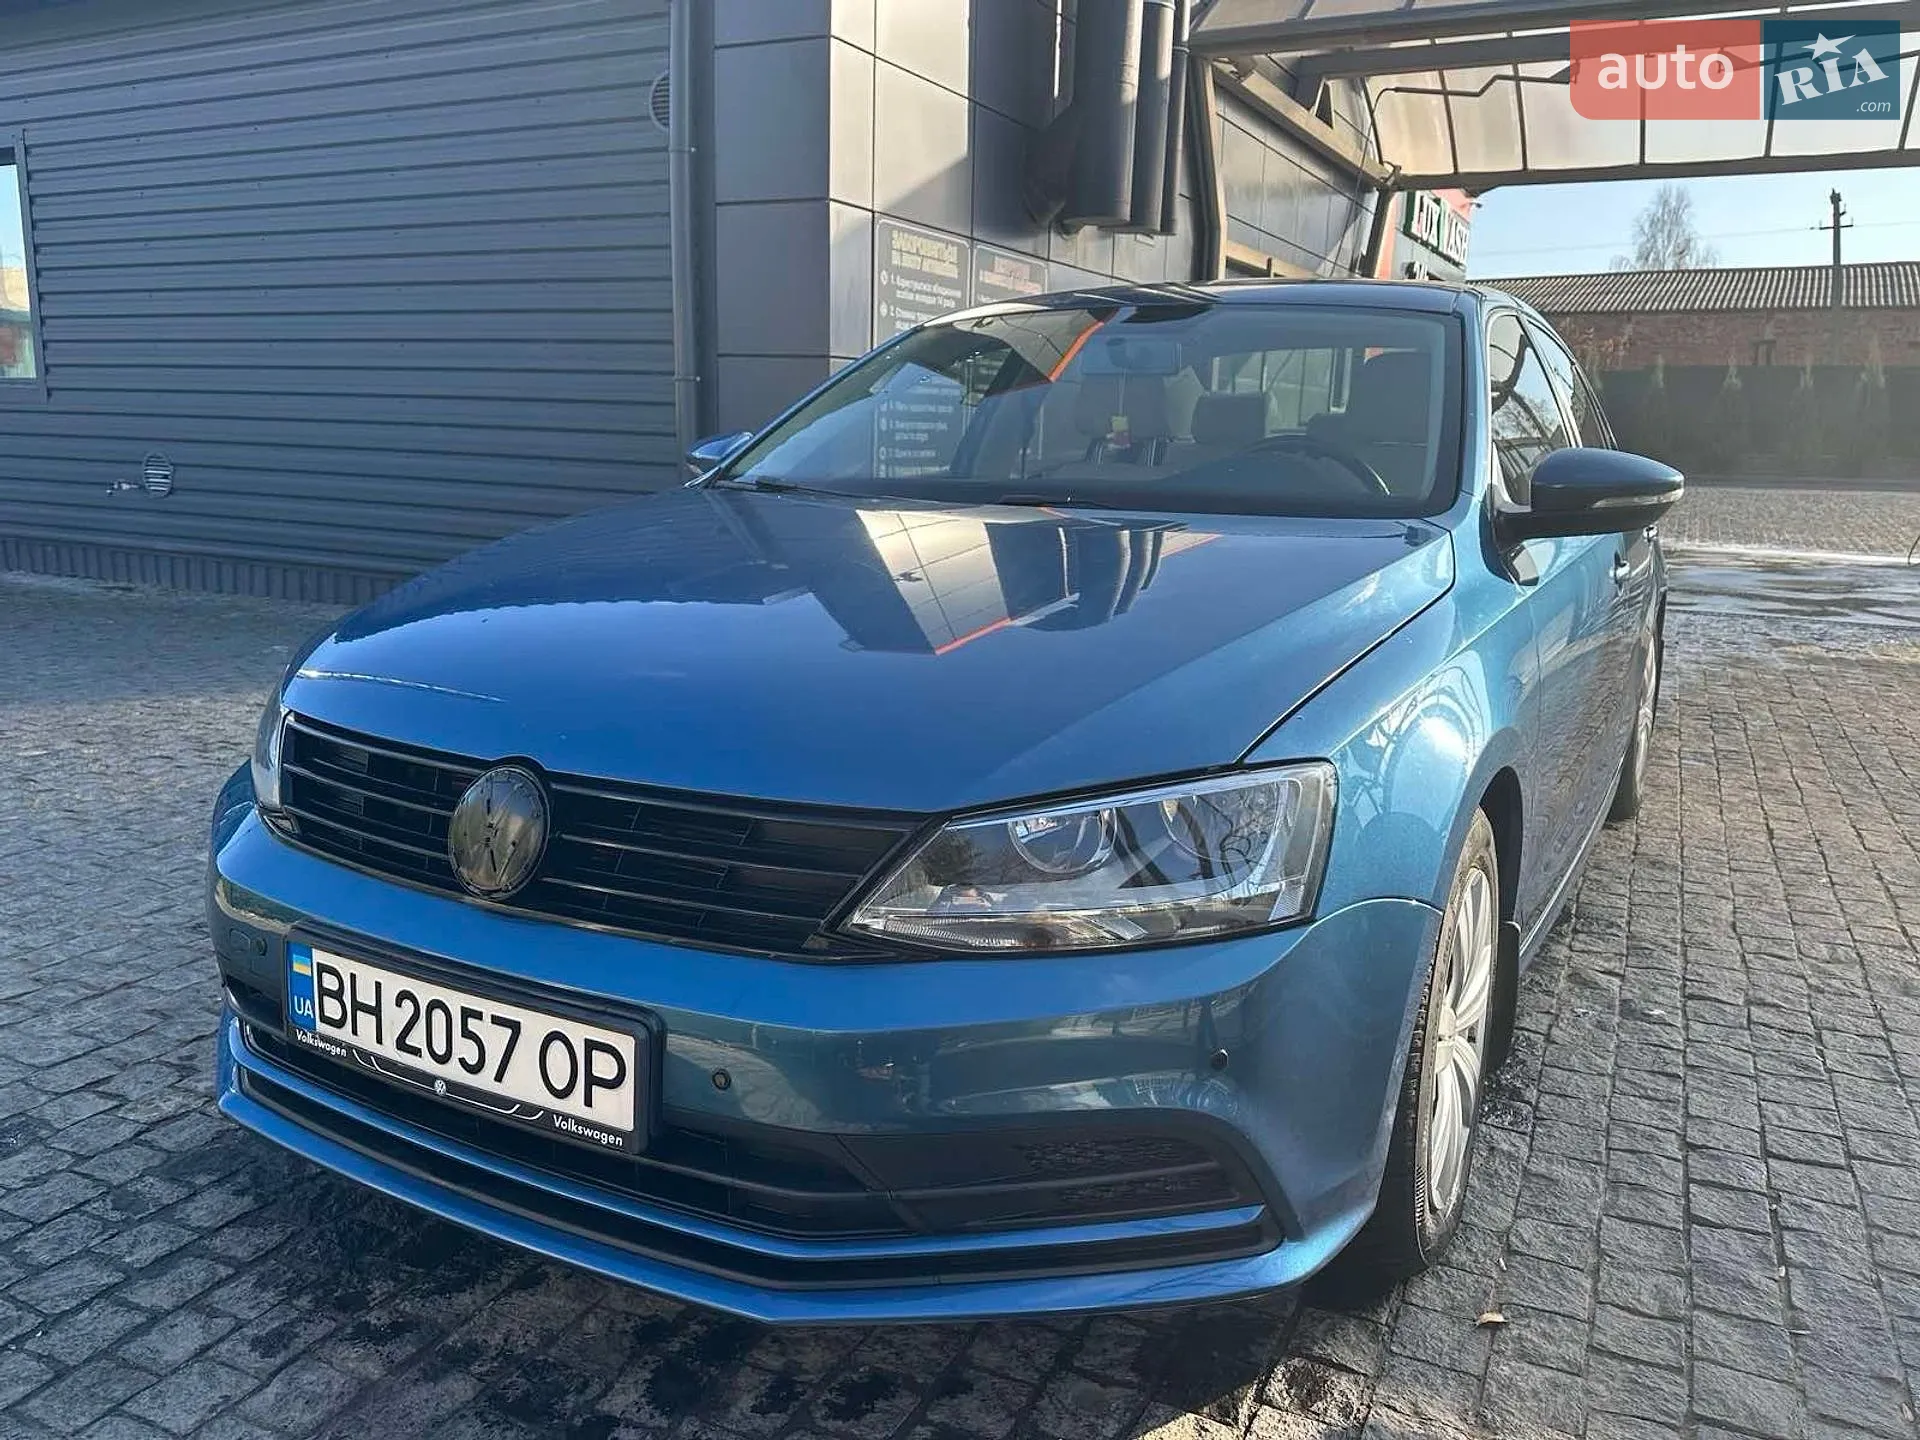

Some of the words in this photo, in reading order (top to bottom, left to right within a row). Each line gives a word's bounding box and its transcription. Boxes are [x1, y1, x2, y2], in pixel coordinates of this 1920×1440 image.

[1411, 190, 1441, 248] LUX
[294, 995, 314, 1019] UA
[295, 1028, 347, 1058] Volkswagen
[316, 961, 383, 1046] BH
[394, 989, 522, 1084] 2057
[538, 1030, 627, 1108] OP
[553, 1114, 623, 1147] Volkswagen
